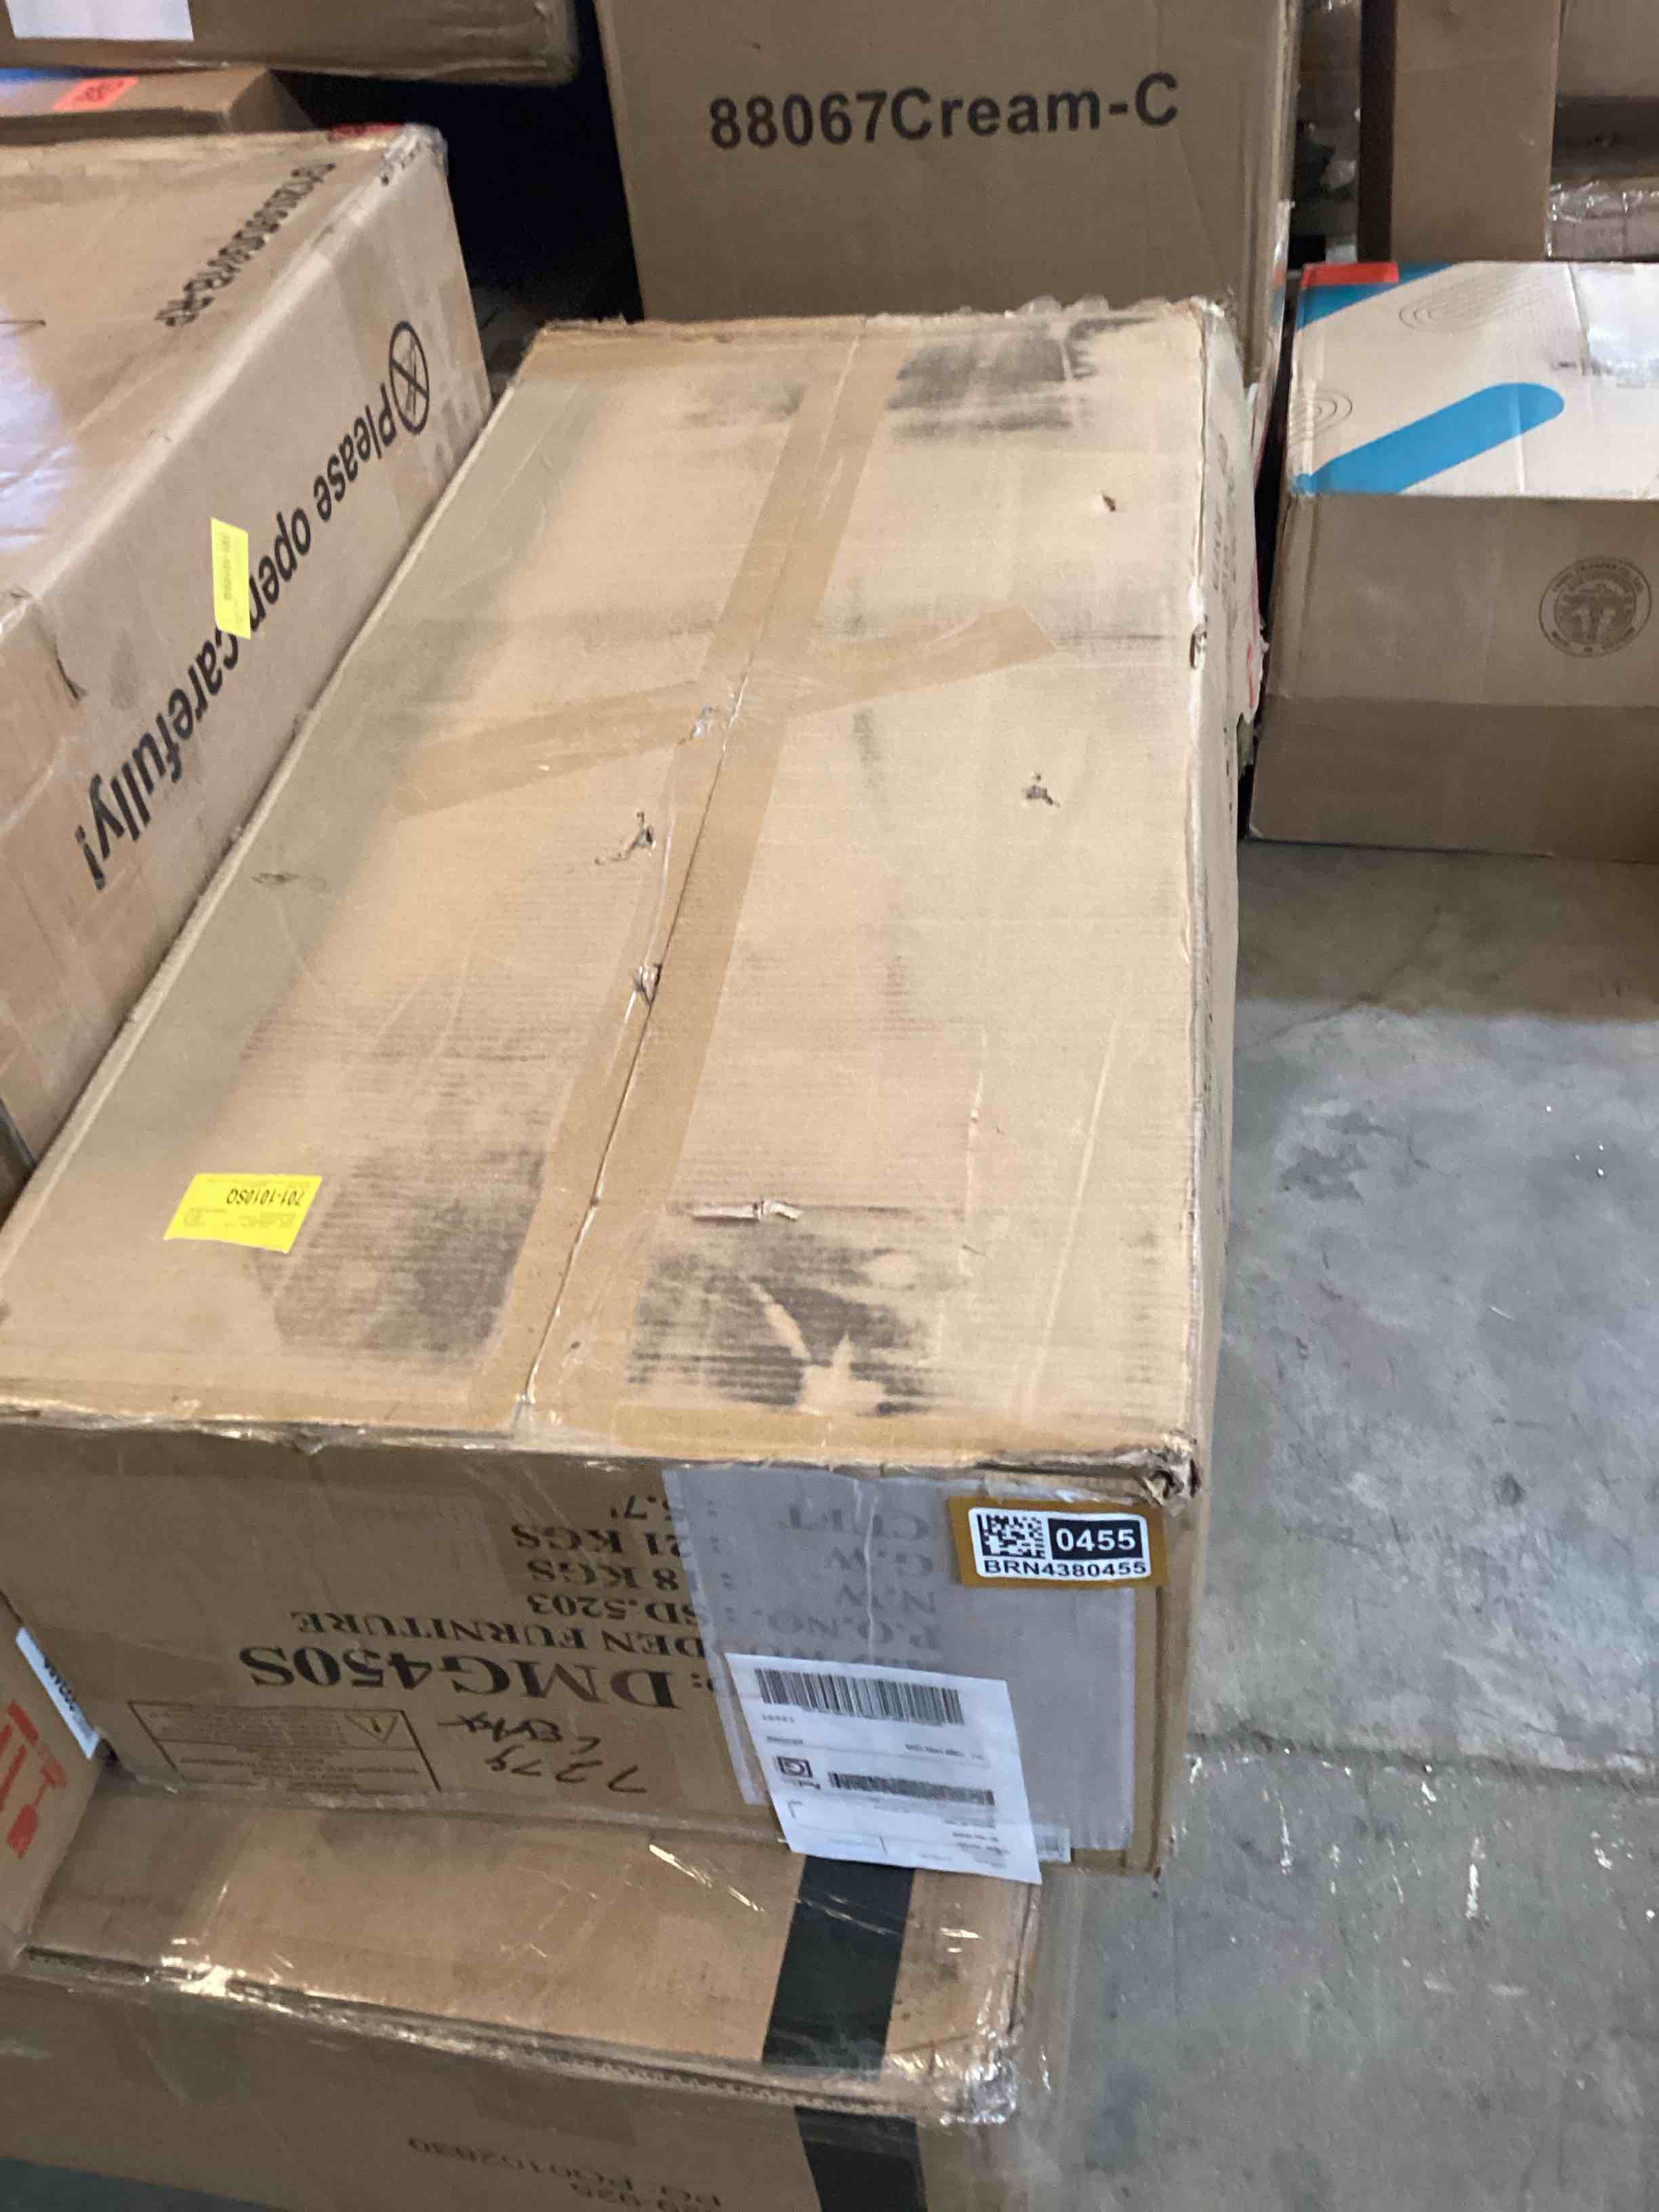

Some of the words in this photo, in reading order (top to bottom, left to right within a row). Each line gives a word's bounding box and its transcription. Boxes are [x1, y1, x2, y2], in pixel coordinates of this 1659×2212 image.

[710, 72, 1178, 148] 88067Cream-C
[313, 382, 397, 523] Please
[511, 1525, 623, 1554] KGS
[1055, 1528, 1136, 1552] 0455
[527, 1559, 640, 1589] KGS
[984, 1559, 1147, 1578] BRN4380455
[291, 1610, 588, 1651] FURNITURE
[600, 1628, 706, 1660] DEN
[238, 1645, 683, 1711] DMG450S
